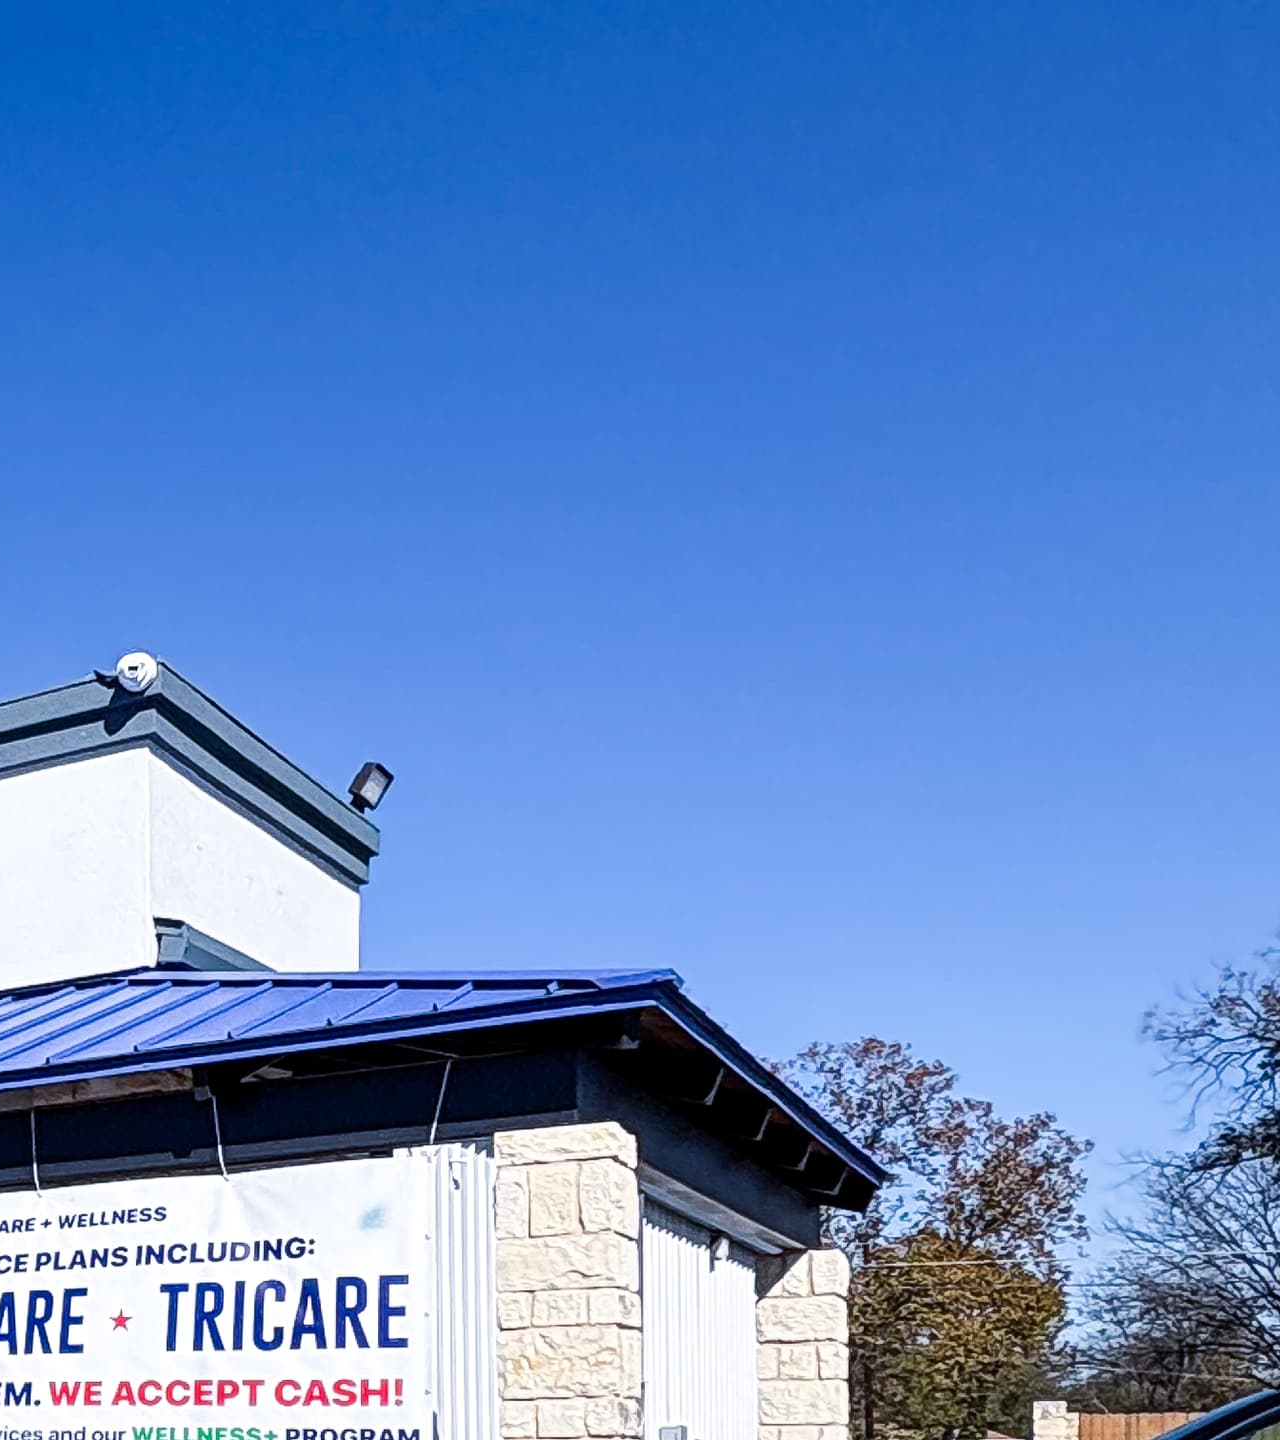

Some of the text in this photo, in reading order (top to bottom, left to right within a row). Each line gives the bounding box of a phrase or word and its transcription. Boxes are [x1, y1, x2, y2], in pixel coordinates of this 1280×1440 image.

[58, 1206, 167, 1230] WELLNESS
[35, 1246, 129, 1272] PLANS
[135, 1236, 315, 1266] INCLUDING:
[160, 1274, 409, 1352] TRICARE
[49, 1380, 102, 1407] WE
[111, 1379, 265, 1407] ACCEPT
[274, 1378, 404, 1407] CASH!
